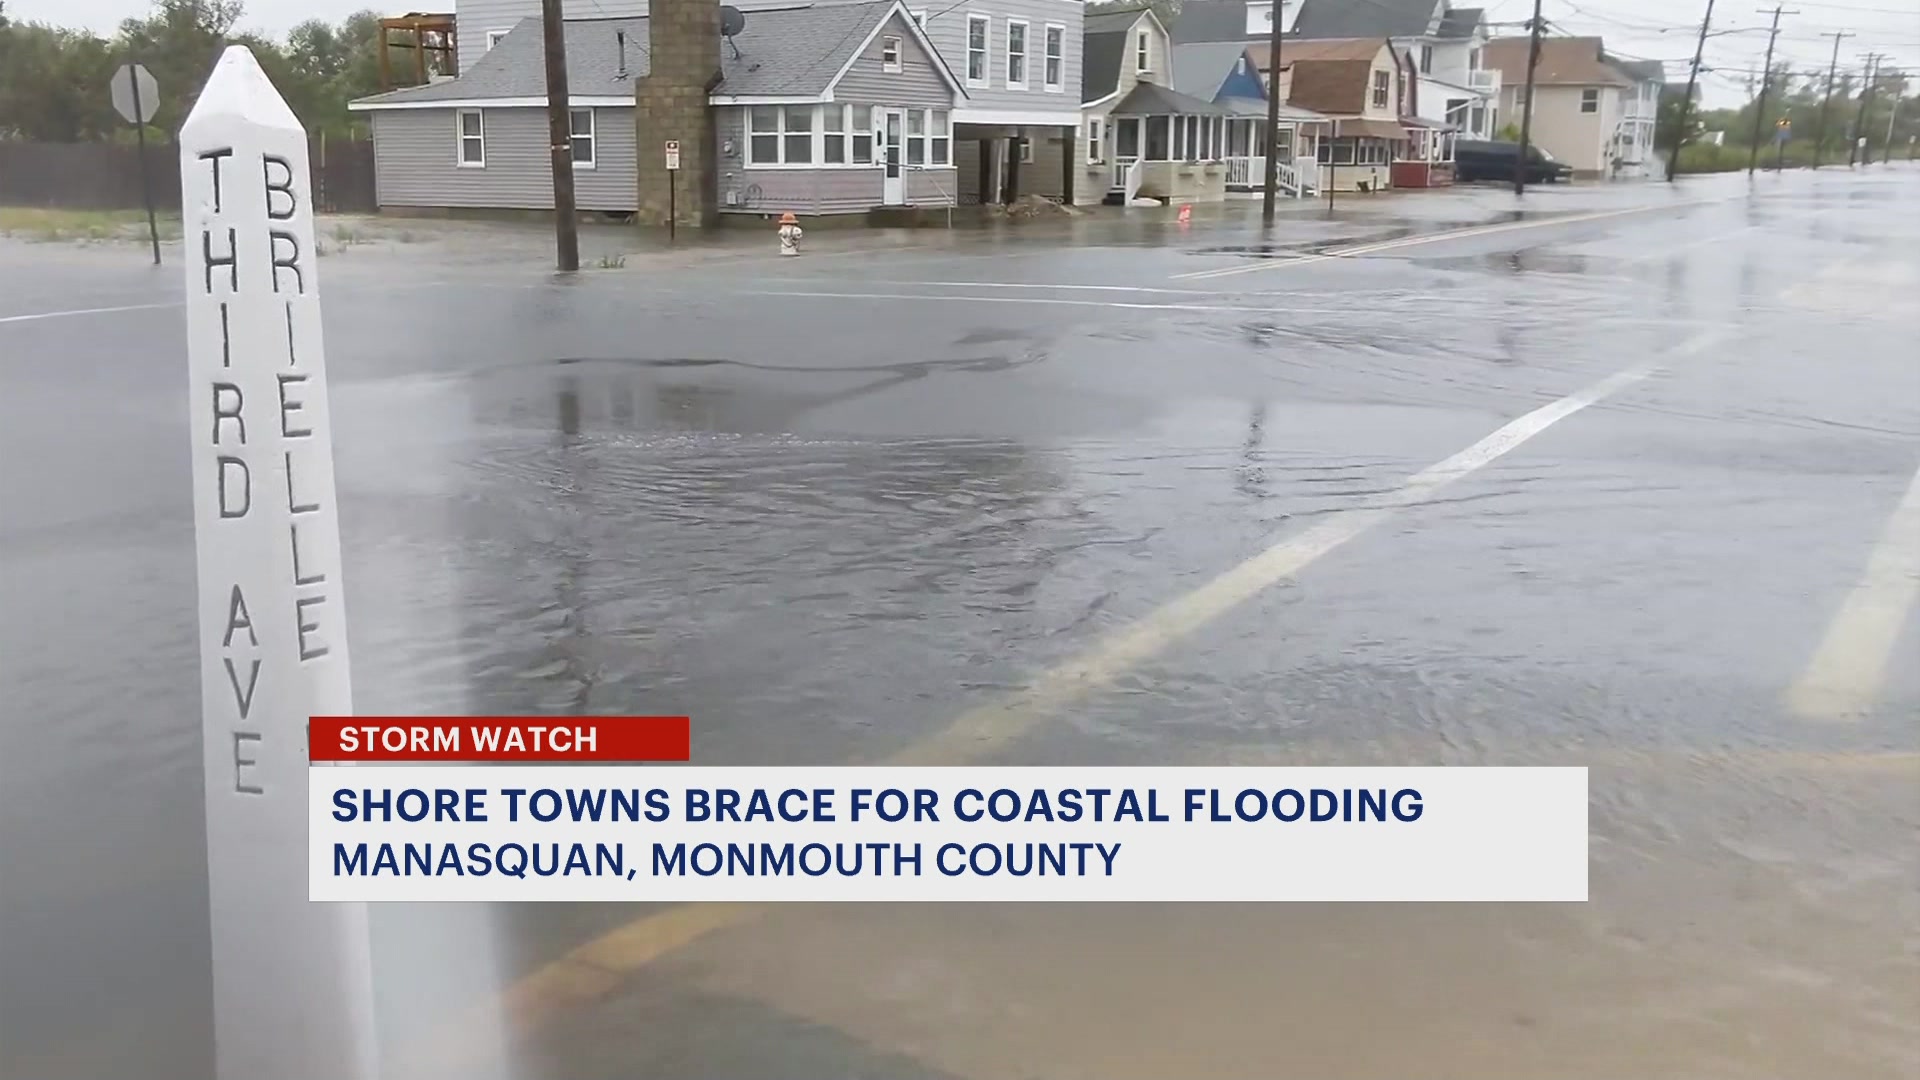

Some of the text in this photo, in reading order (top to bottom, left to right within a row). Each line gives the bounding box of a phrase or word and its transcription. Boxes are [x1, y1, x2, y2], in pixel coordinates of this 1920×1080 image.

[198, 147, 264, 795] THIRD AVE
[262, 152, 329, 662] BRIELLE
